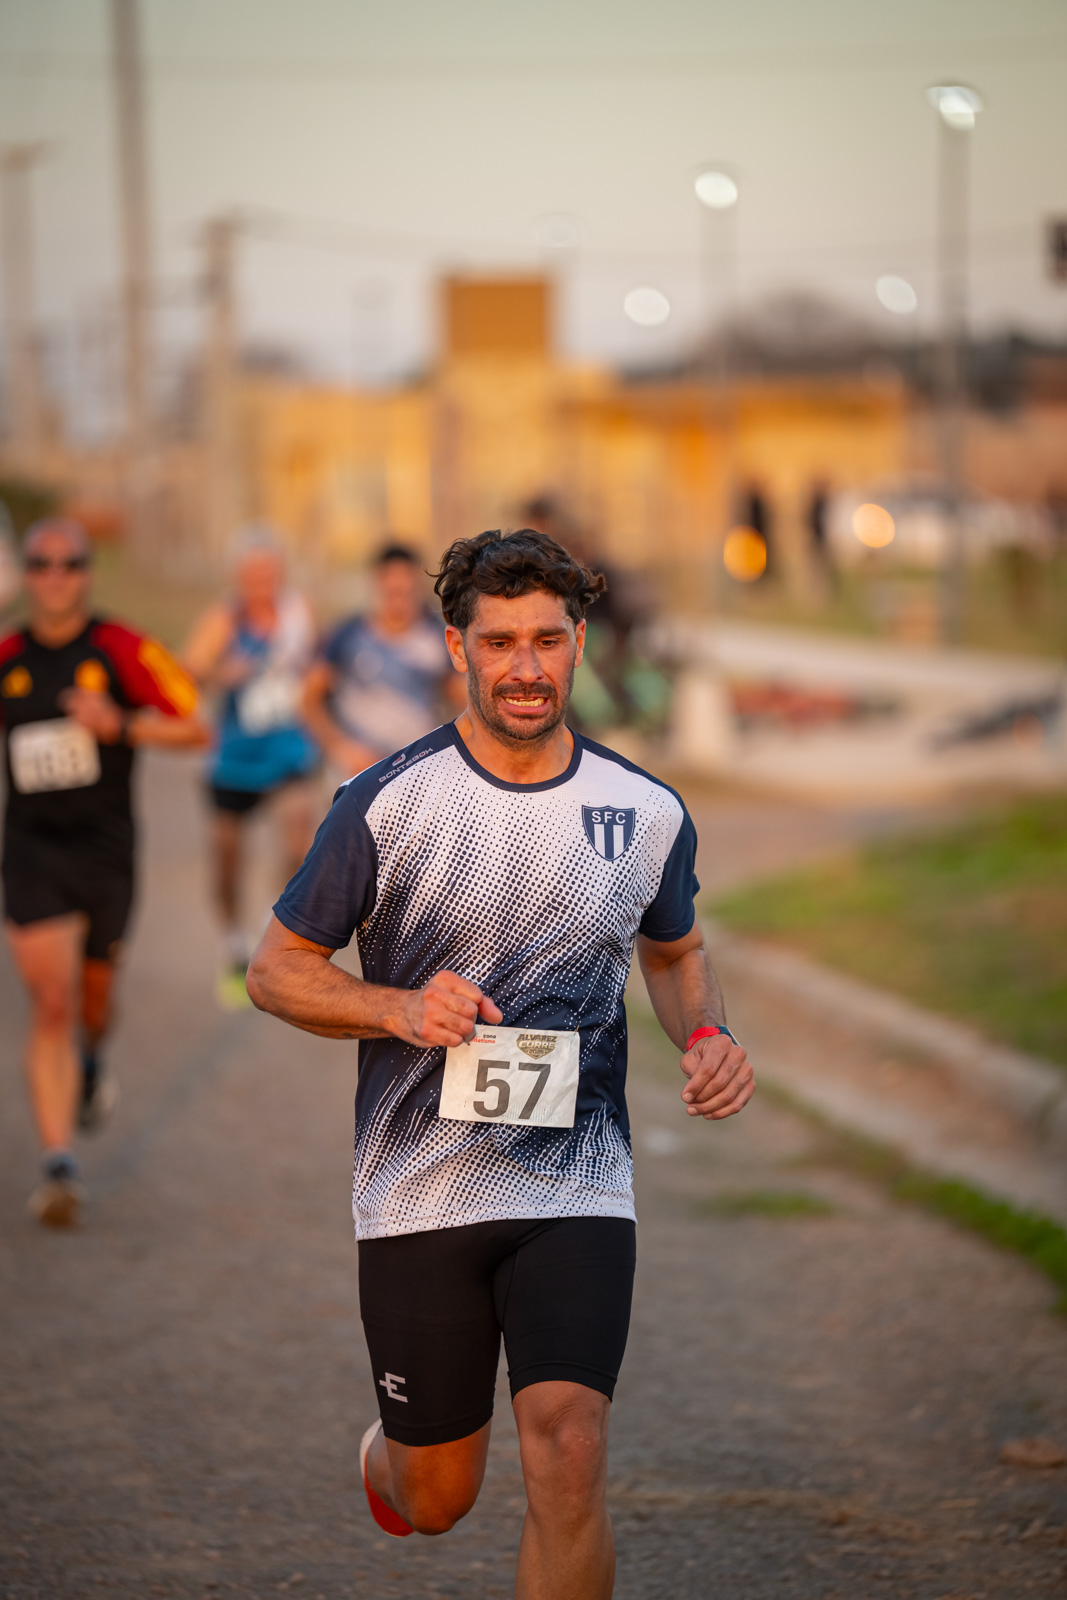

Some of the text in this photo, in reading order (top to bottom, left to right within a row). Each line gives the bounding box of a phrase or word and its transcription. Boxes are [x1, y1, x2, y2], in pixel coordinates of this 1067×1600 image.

[591, 810, 626, 824] SFC
[519, 1033, 558, 1043] ALVAREZ
[518, 1040, 556, 1049] CORRE
[473, 1058, 552, 1120] 57
